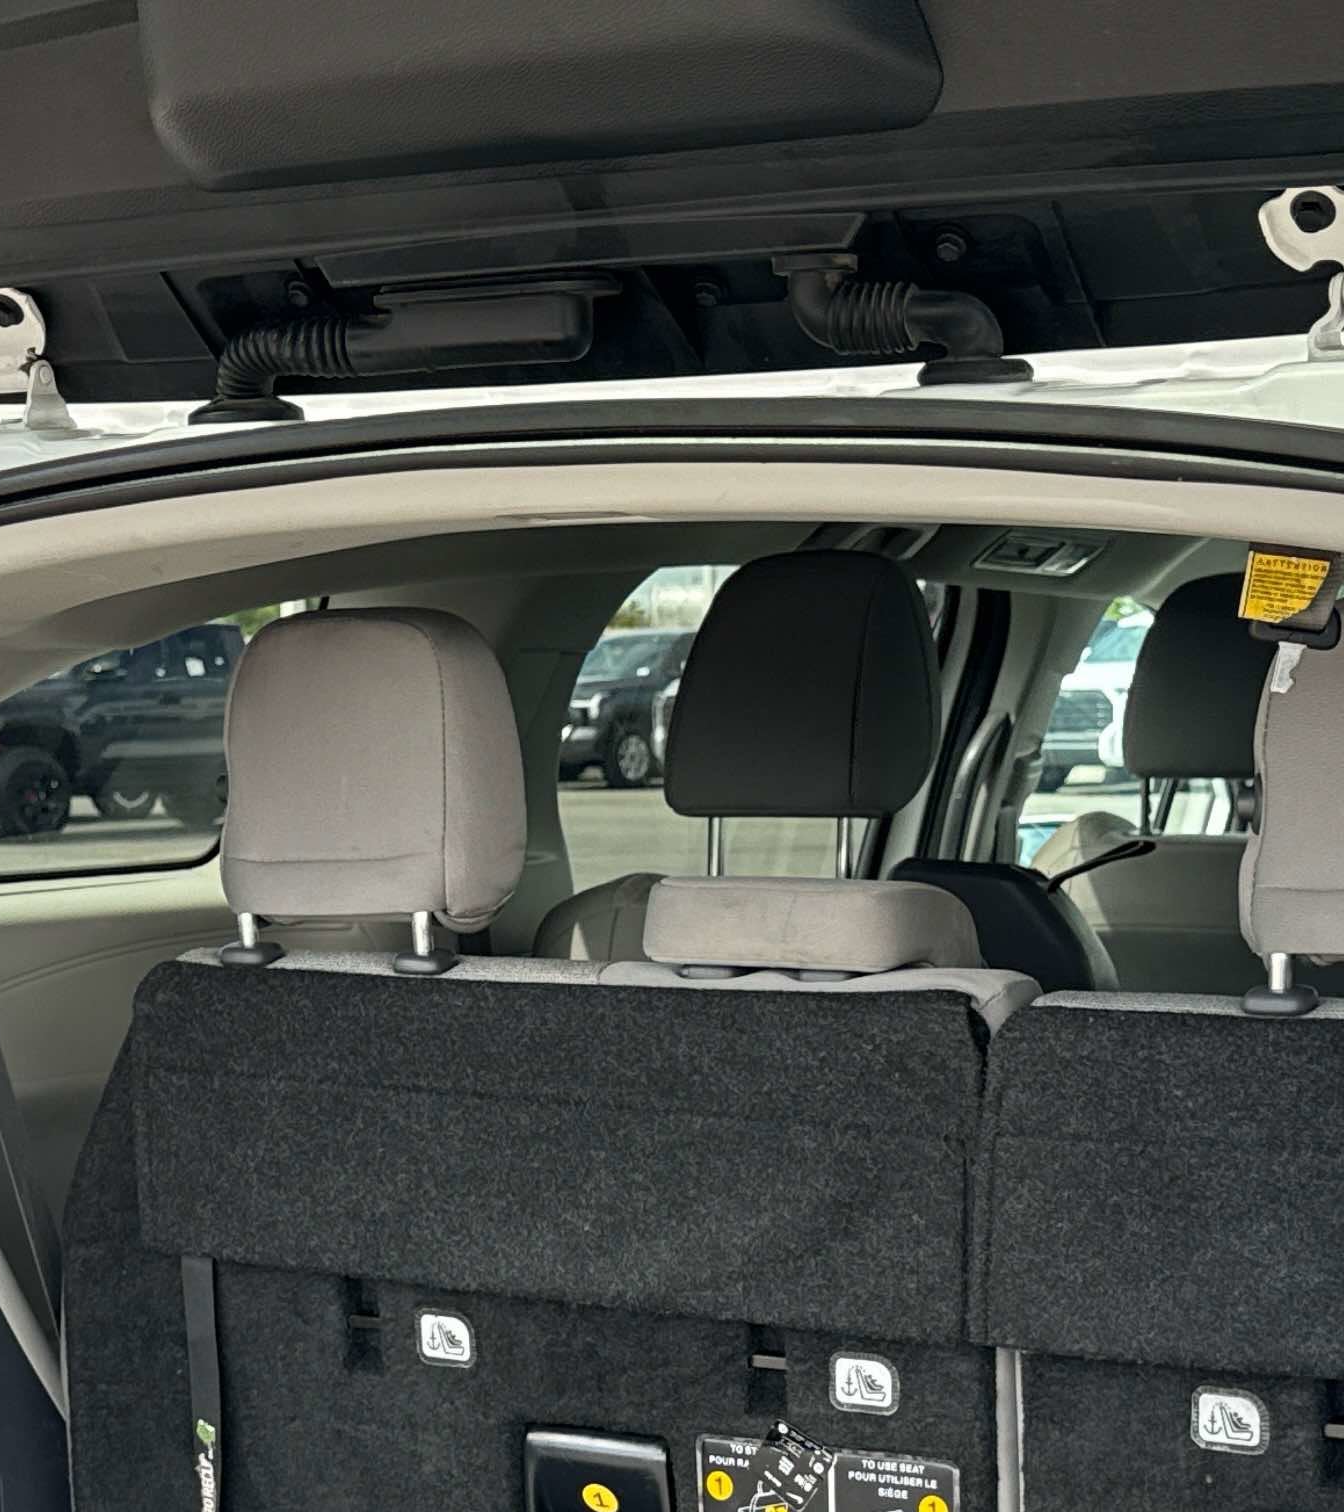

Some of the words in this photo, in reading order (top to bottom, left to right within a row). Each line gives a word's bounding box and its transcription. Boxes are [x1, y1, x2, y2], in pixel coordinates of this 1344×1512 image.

[729, 1444, 743, 1454] TO
[744, 1445, 758, 1456] ST
[708, 1455, 735, 1466] POUR
[862, 1459, 875, 1470] TO
[877, 1461, 897, 1472] USE
[899, 1462, 925, 1474] SEAT
[848, 1471, 877, 1483] POUR
[878, 1474, 923, 1488] UTILISER
[924, 1479, 938, 1489] LE
[593, 1490, 609, 1508] 1
